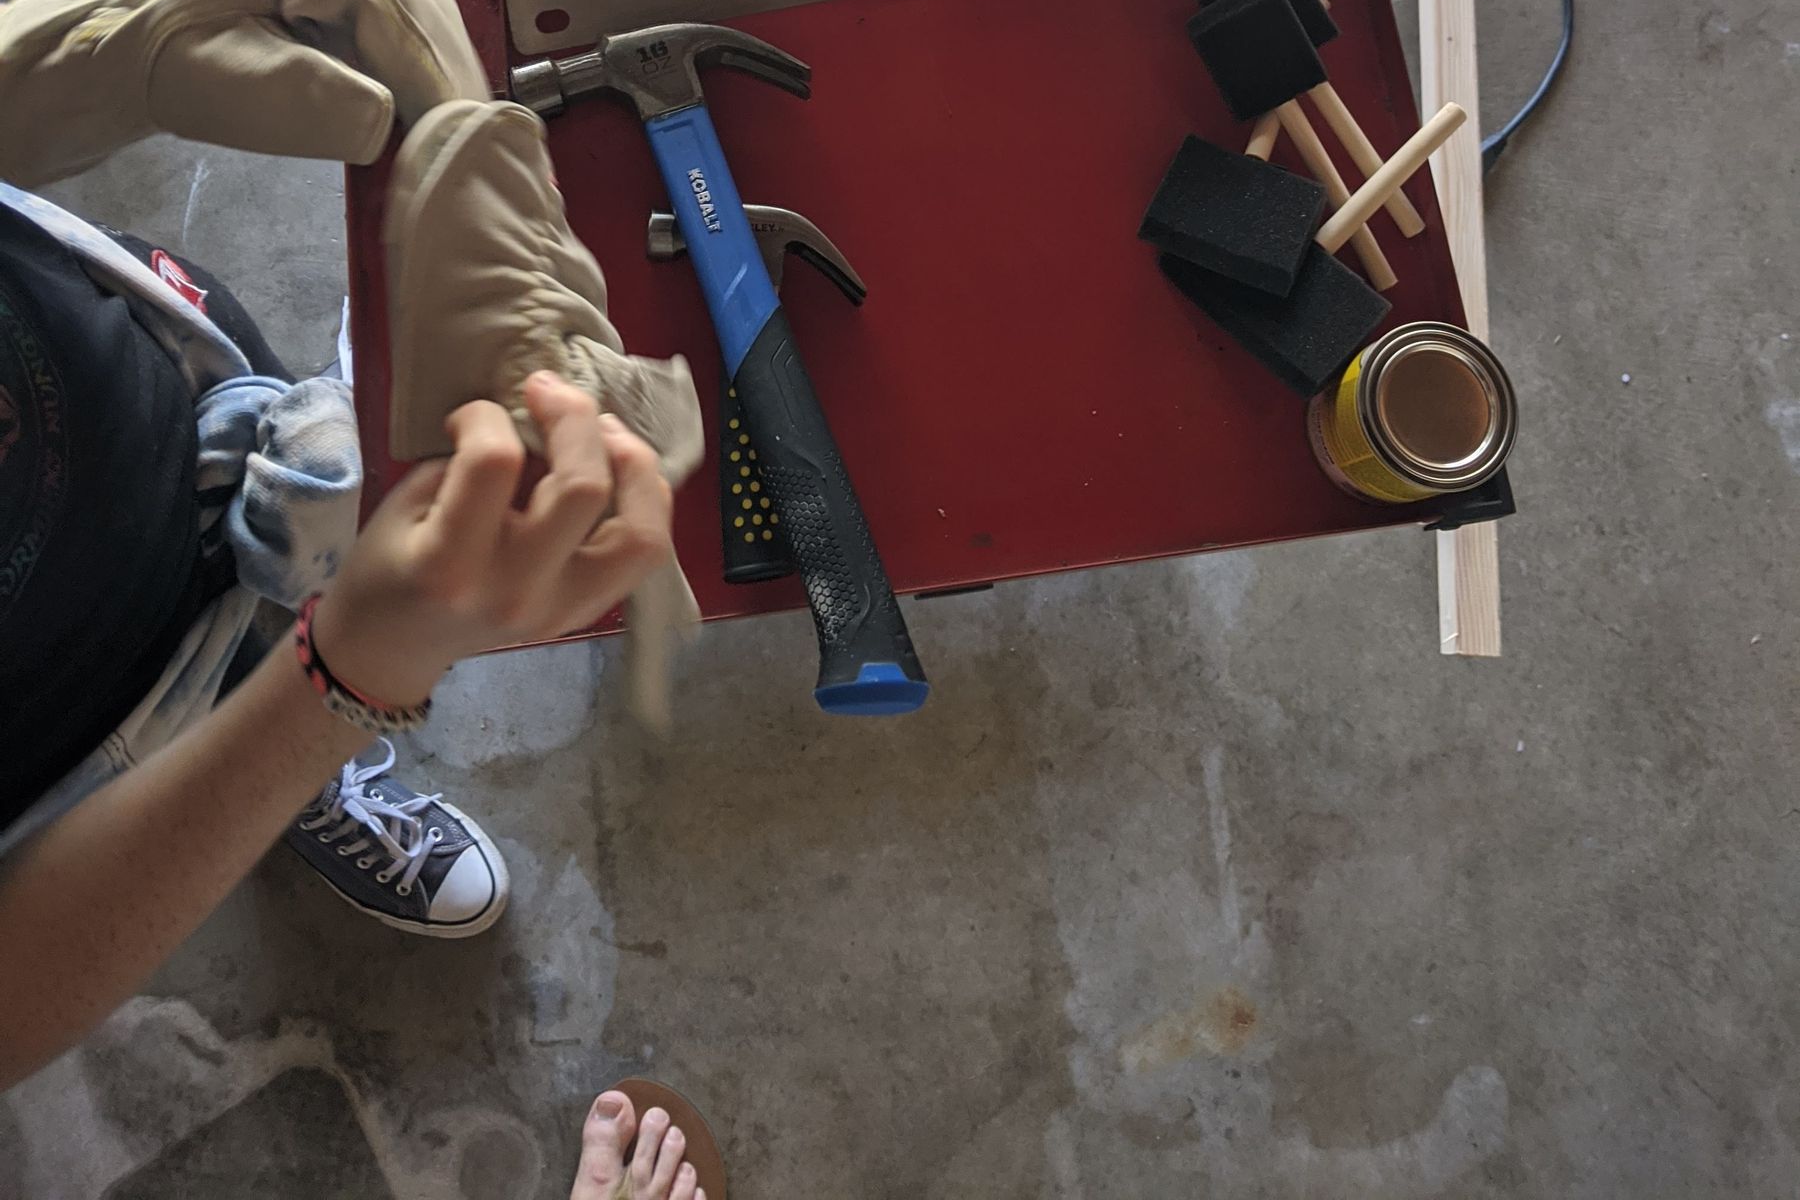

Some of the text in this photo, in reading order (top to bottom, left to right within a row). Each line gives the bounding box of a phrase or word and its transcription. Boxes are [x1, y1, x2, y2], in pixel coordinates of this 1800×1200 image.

[636, 40, 669, 64] 16
[687, 167, 722, 232] KOBALT
[751, 223, 776, 233] LEY
